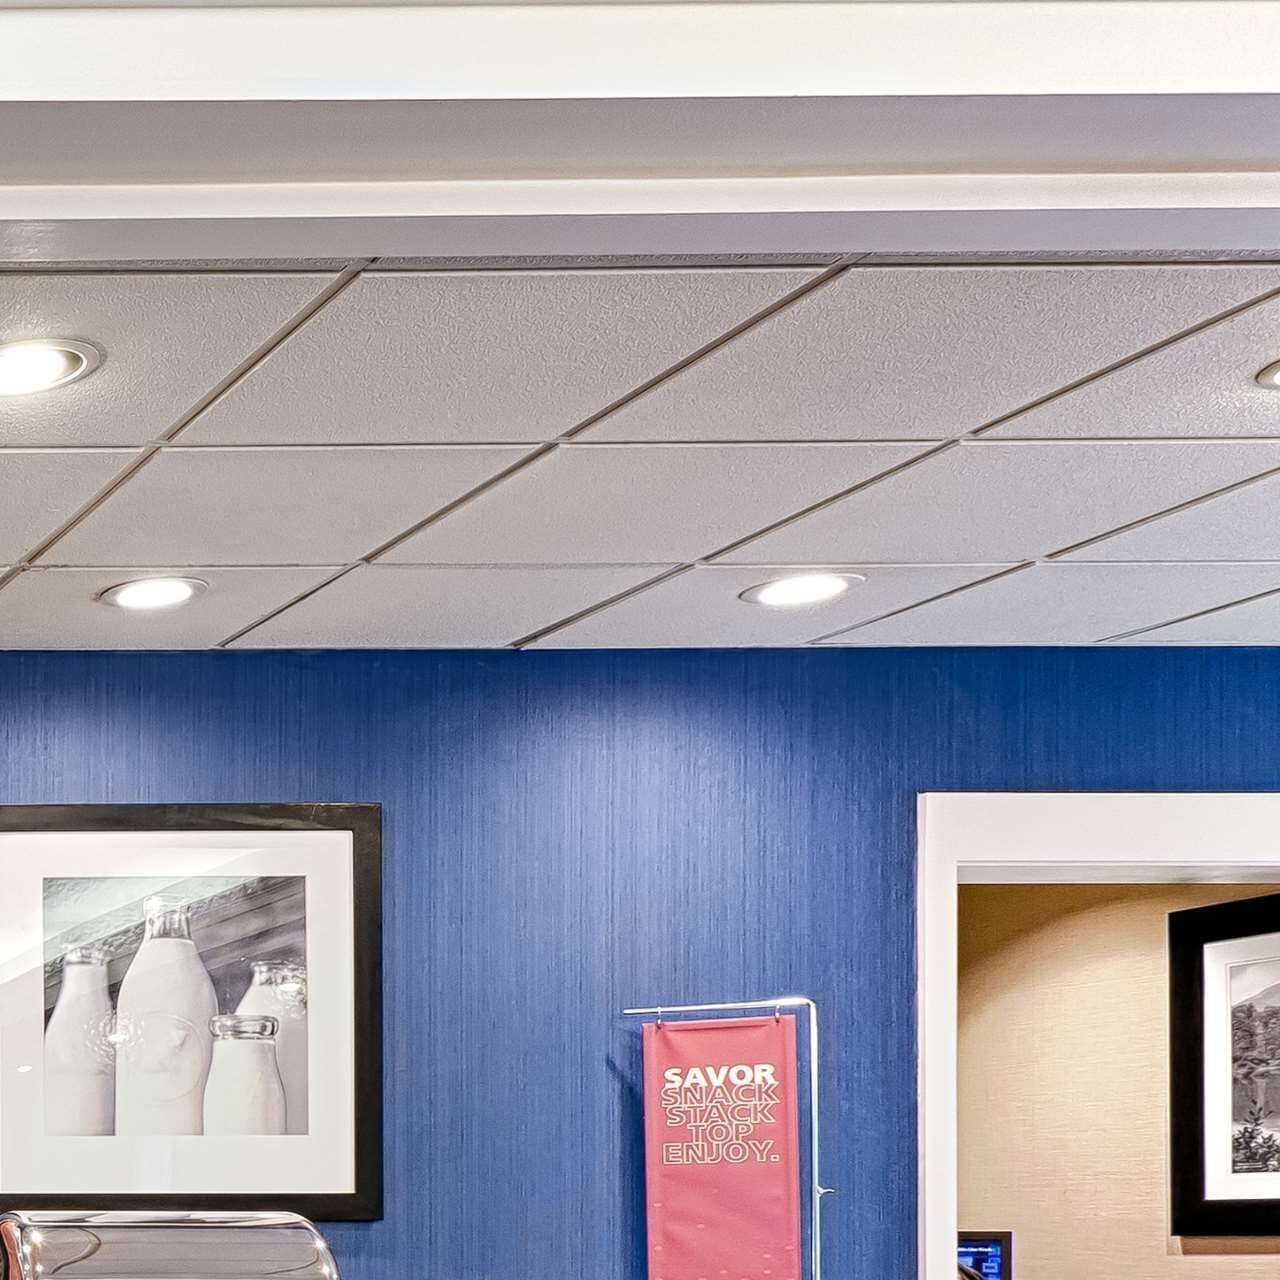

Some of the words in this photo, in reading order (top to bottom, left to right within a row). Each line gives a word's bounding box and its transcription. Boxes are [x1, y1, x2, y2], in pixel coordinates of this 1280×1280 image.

[663, 1063, 777, 1088] SAVOR
[661, 1081, 782, 1107] SNACK
[666, 1102, 778, 1127] STACK
[687, 1121, 754, 1145] TOP
[663, 1140, 781, 1165] ENJOY.
